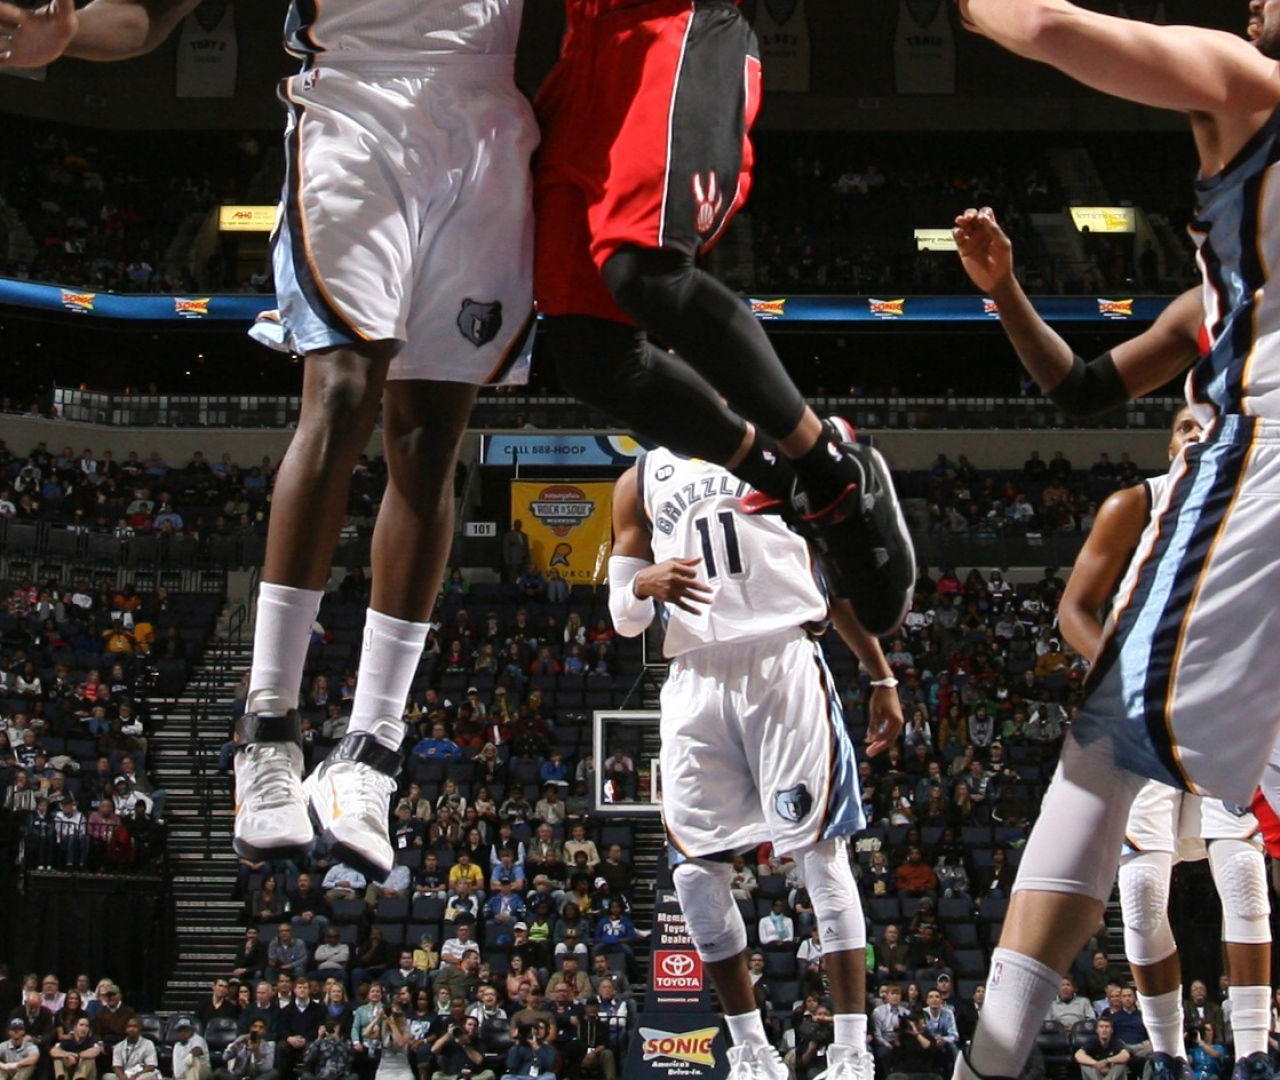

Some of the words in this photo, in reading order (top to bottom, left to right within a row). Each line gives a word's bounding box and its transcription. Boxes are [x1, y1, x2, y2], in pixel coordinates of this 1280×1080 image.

[656, 476, 756, 536] GRIZZLI
[473, 524, 491, 534] 101
[695, 511, 743, 580] 11
[656, 977, 700, 987] TOYOTA
[645, 1037, 712, 1055] SONIC
